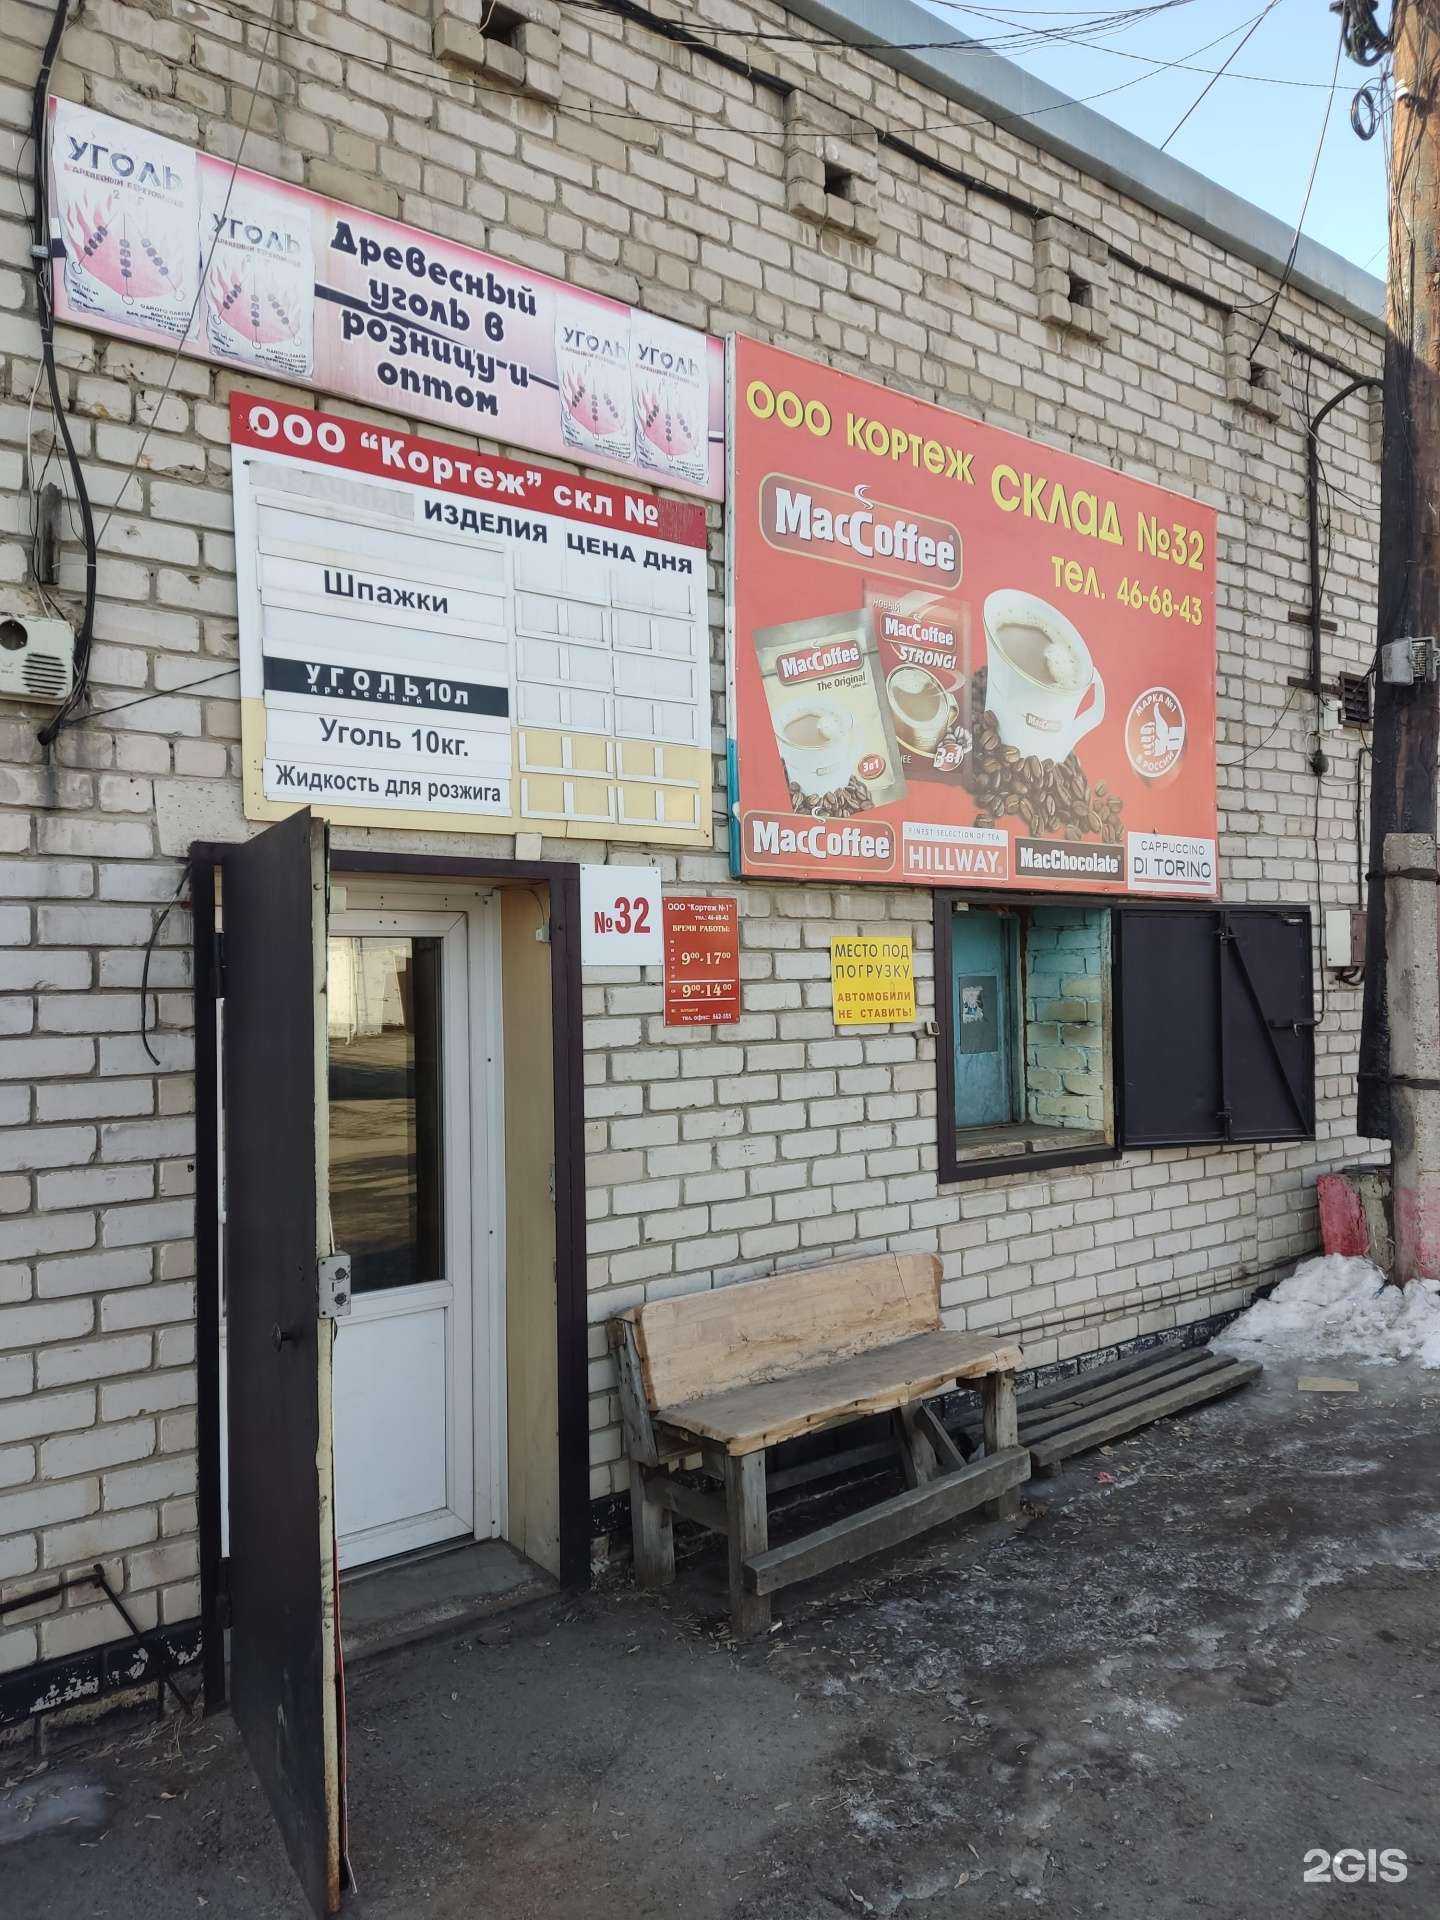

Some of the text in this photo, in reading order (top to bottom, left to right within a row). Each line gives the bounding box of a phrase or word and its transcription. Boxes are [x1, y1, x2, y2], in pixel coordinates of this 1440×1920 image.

[68, 135, 183, 191] УГОЛЬ
[212, 213, 301, 253] УГОЛЬ
[330, 220, 538, 317] Древесный
[369, 278, 471, 332] уголь
[563, 326, 626, 359] УГОЛЬ
[638, 343, 700, 377] УГОЛЬ
[376, 361, 500, 417] оптом
[247, 406, 347, 455] ООО
[553, 484, 613, 518] скл
[624, 497, 660, 528] №
[745, 380, 832, 437] ООО
[1136, 510, 1206, 572] №32
[423, 498, 694, 575] ИЗДЕЛИЯ ЦЕНА ДНЯ
[774, 486, 957, 573] MacCoffee
[323, 569, 449, 615] Шпажки
[1116, 575, 1204, 627] 46-68-43
[884, 617, 954, 647] MacCoffee
[781, 646, 860, 679] MacCoffee
[898, 644, 958, 670] STRONG!
[304, 663, 469, 706] УГОЛЬ 10л
[817, 680, 833, 691] The
[834, 672, 866, 689] Original
[318, 716, 469, 757] Уголь 10кг.
[275, 763, 501, 803] Жидкость для розжига
[752, 819, 890, 861] MacCoffee
[1141, 840, 1206, 856] CAPPUCCINO
[908, 844, 1001, 874] HILLWAY
[1019, 846, 1120, 874] MacChocolate
[1133, 857, 1212, 879] DI TORINO
[594, 896, 652, 935] №32
[667, 903, 686, 911] ООО
[672, 924, 697, 932] ВРЕМЯ
[834, 943, 910, 961] МЕСТО ПОД
[835, 964, 910, 979] ПОГРУЗКУ
[837, 991, 911, 1003] АВТОМОБИЛИ
[838, 1006, 913, 1019] НЕ СТАВИТЬ!
